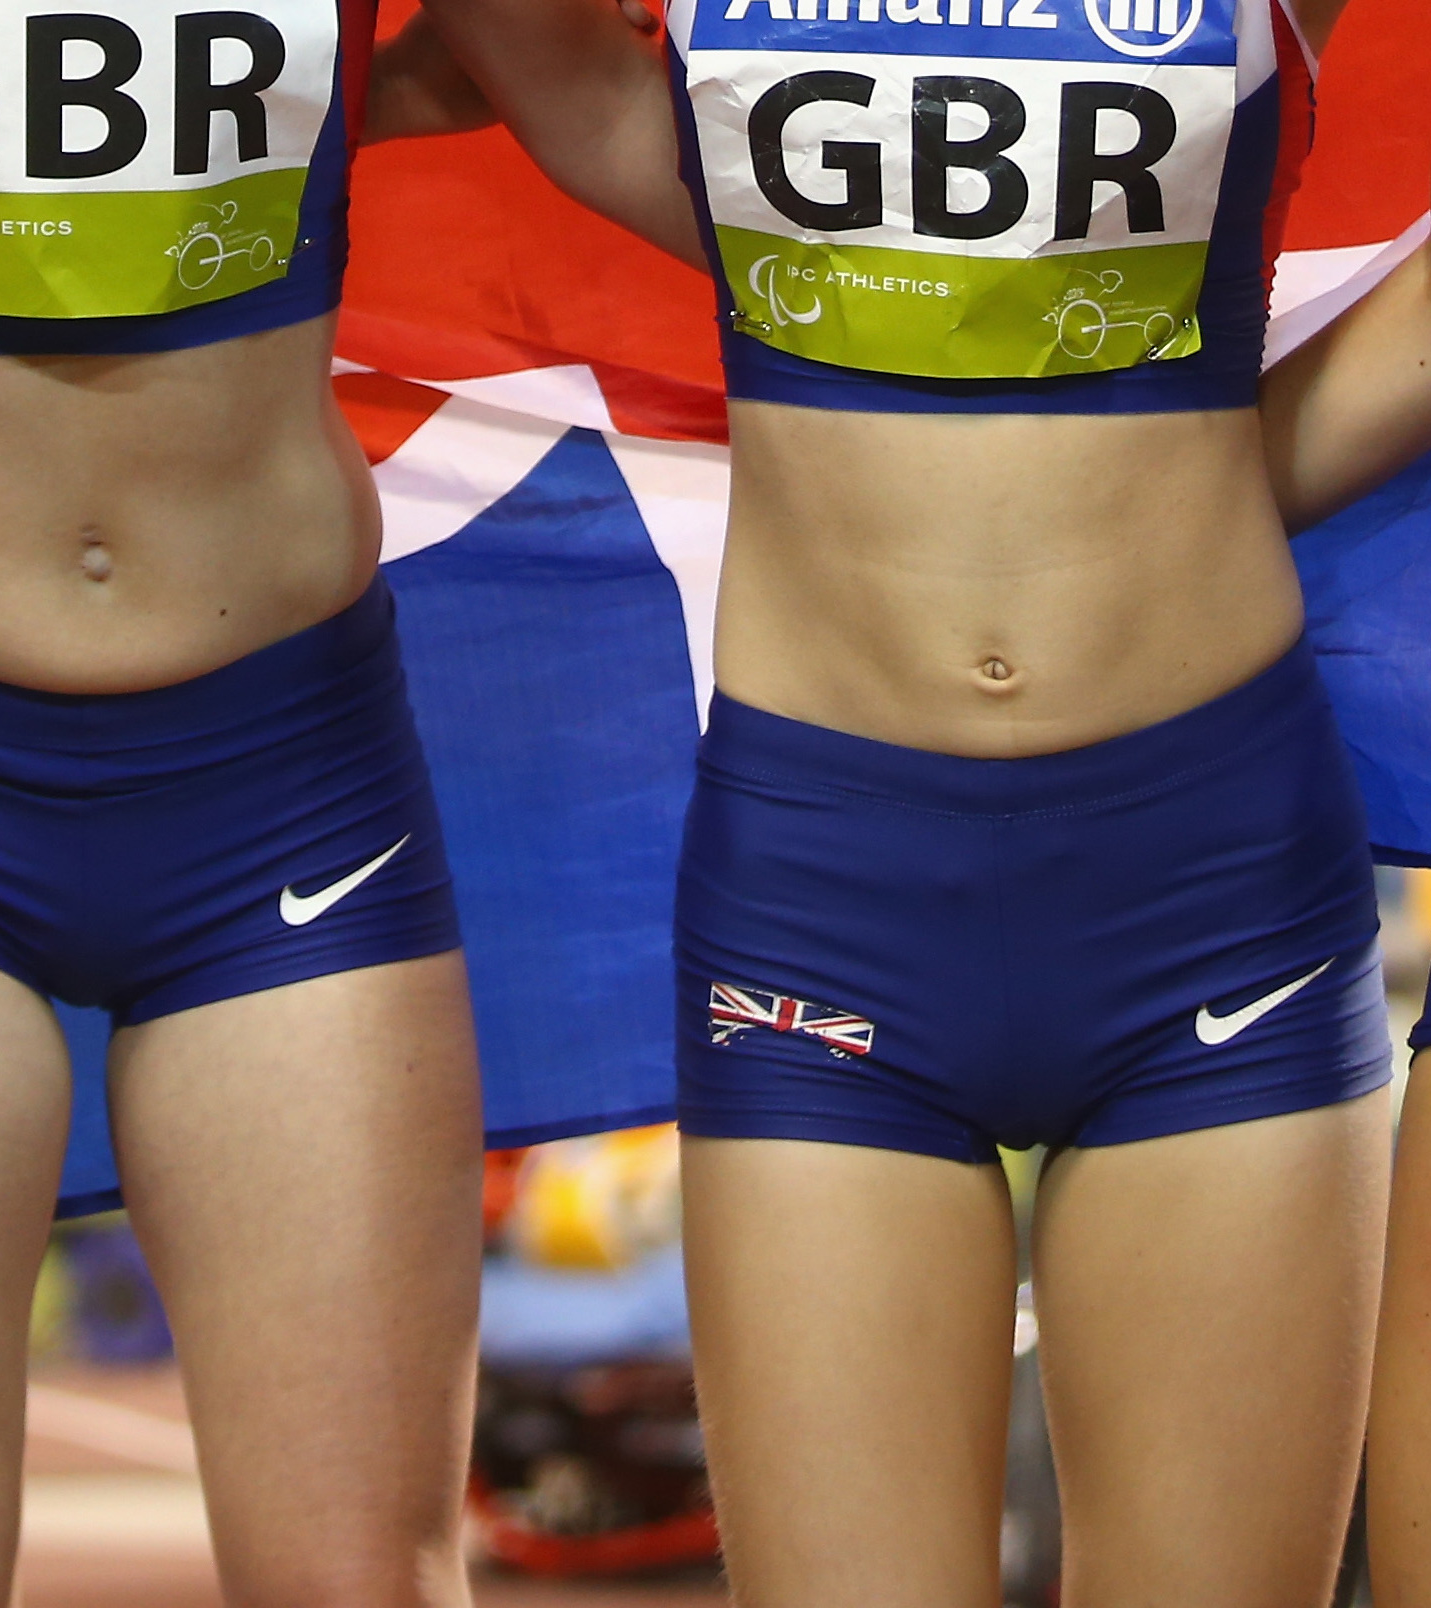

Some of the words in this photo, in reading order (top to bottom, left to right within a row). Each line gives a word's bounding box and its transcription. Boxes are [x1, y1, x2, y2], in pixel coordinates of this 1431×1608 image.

[747, 69, 1177, 242] GBR
[786, 264, 817, 282] IPC
[825, 270, 950, 298] ATHLETICS
